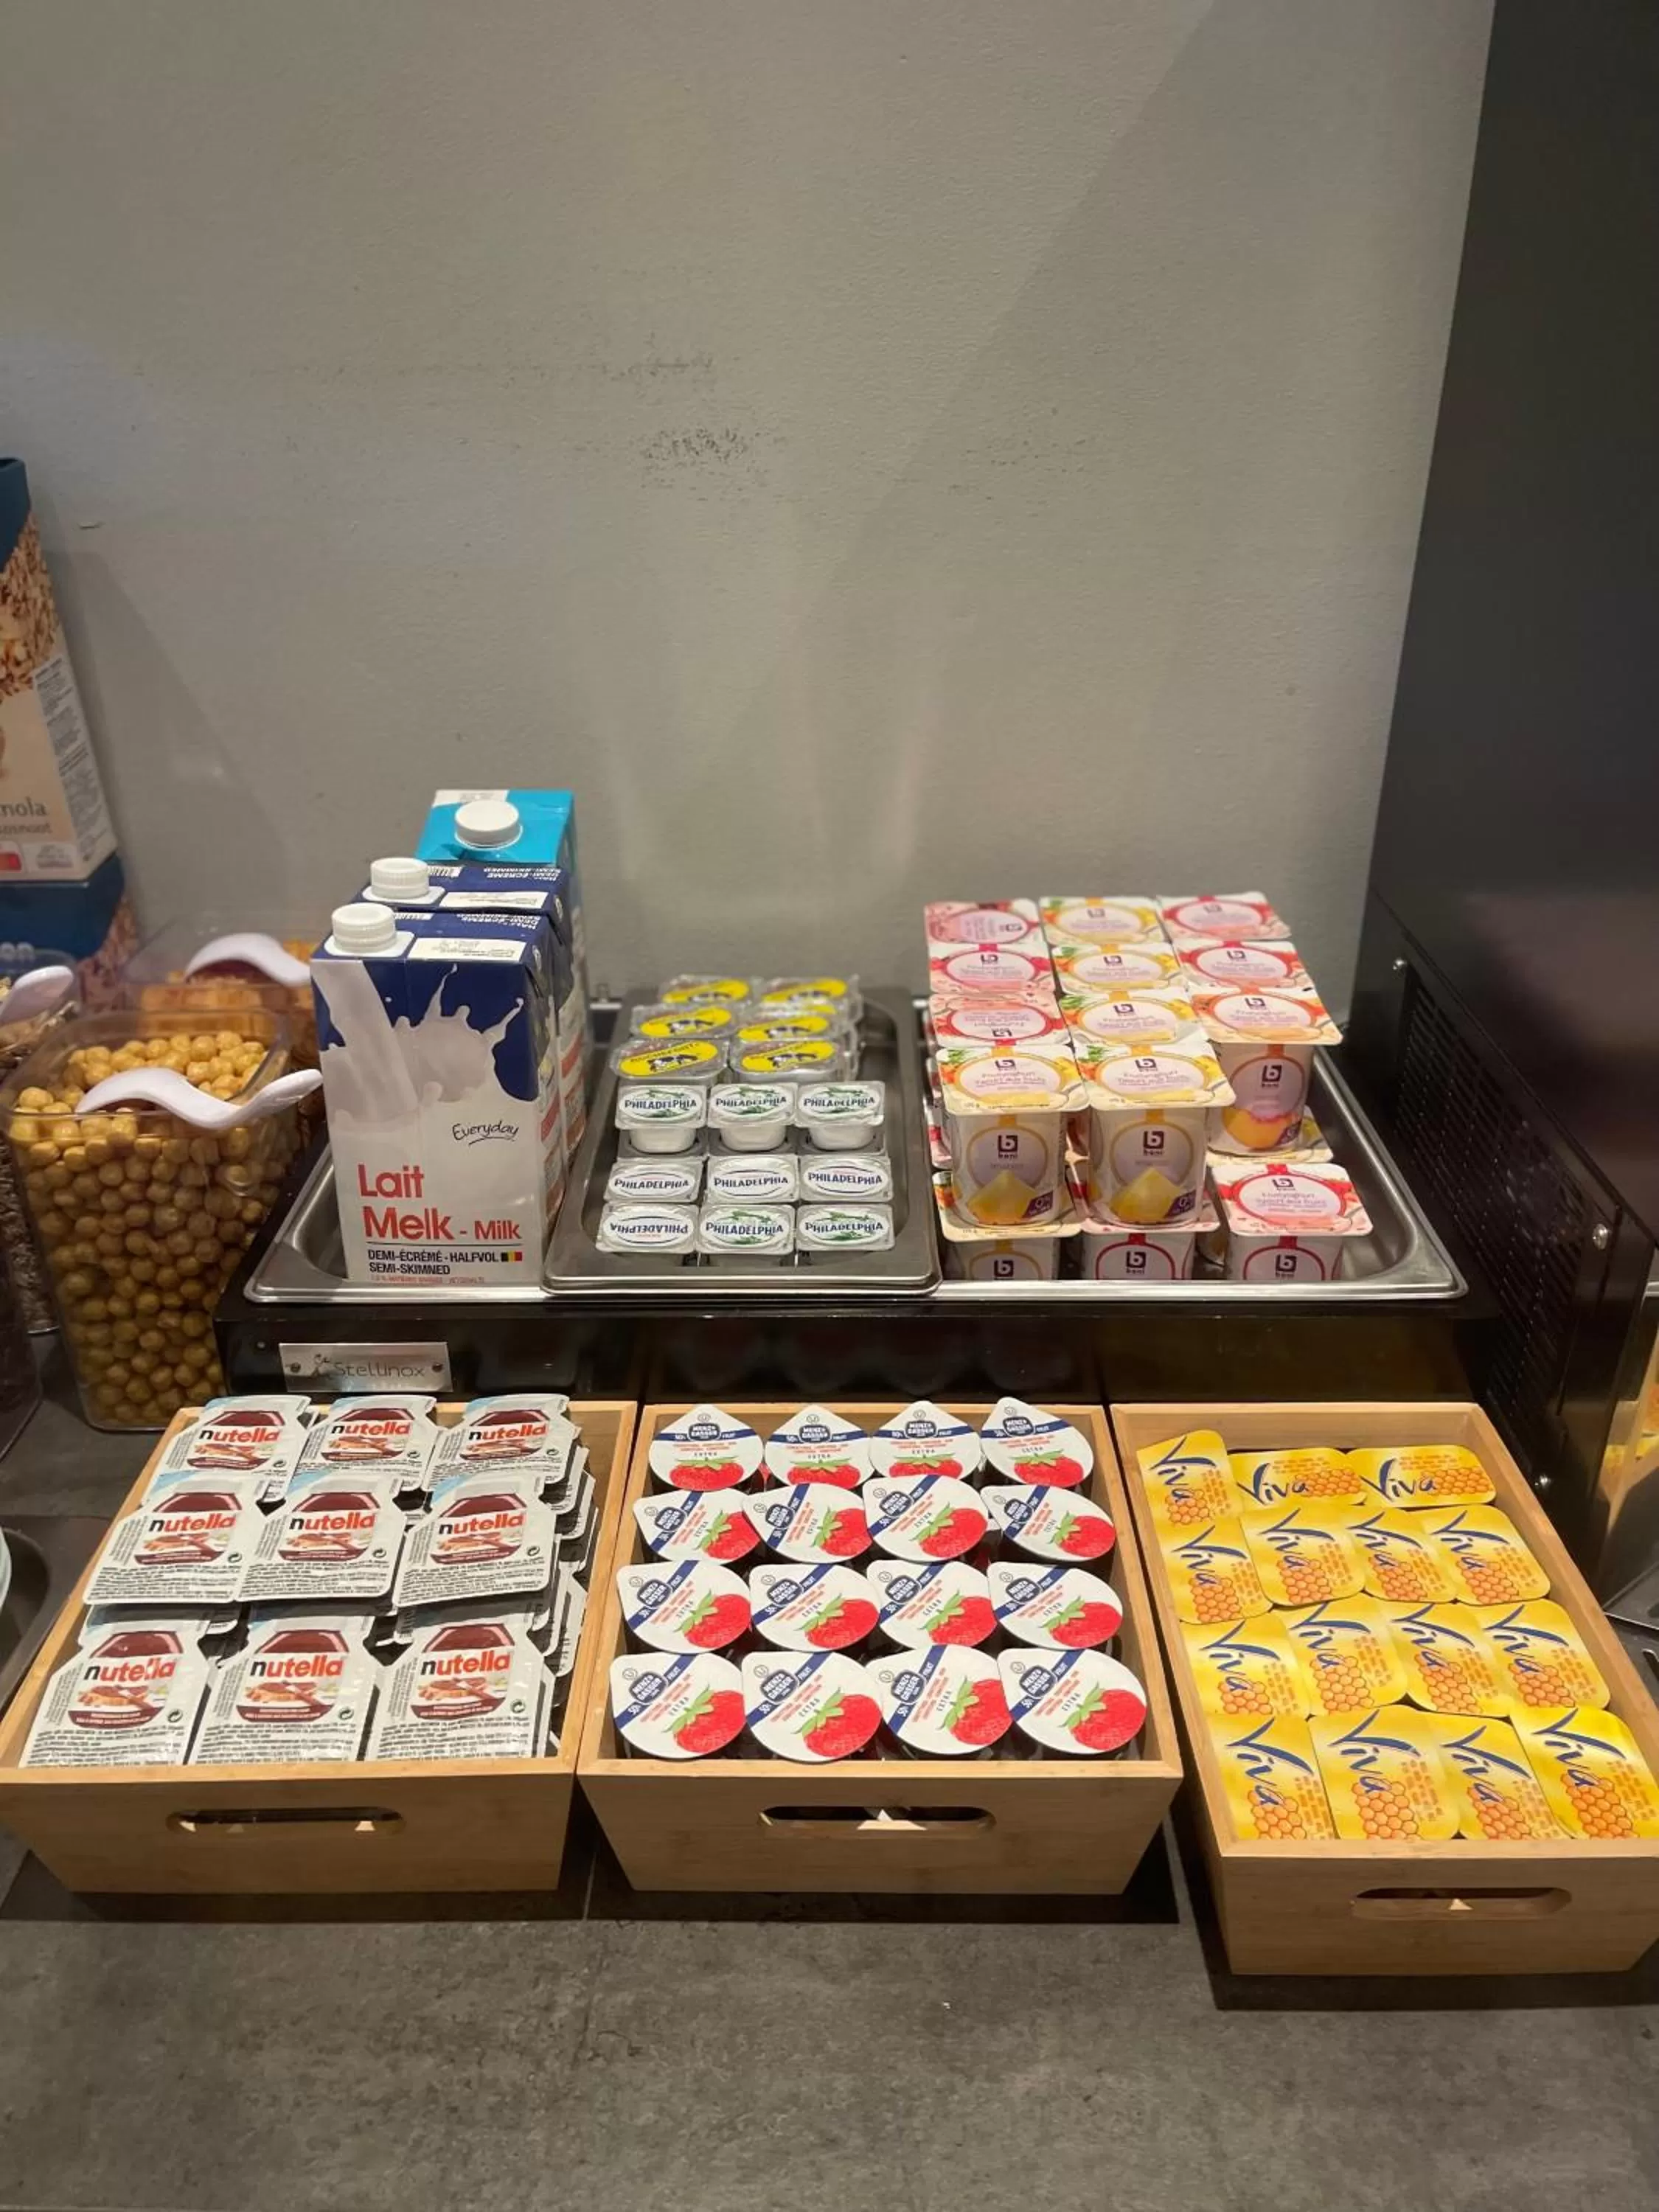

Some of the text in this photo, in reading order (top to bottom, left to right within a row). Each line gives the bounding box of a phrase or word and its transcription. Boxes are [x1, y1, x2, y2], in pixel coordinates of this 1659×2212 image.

[625, 1099, 698, 1110] PHILADELPHIA
[715, 1096, 787, 1107] PHILADELPHIA
[803, 1096, 875, 1107] PHILADELPHIA
[451, 1120, 519, 1141] Everyday
[358, 1164, 424, 1198] Lait
[614, 1179, 689, 1189] PHILADELPHIA
[714, 1176, 789, 1187] PHILADELPHIA
[807, 1172, 883, 1184] PHILADELPHIA
[362, 1206, 454, 1239] Melk
[475, 1220, 522, 1239] Milk
[611, 1222, 689, 1234] PHILADELPHIA
[705, 1221, 785, 1236] PHILADELPHIA
[804, 1221, 884, 1233] PHILADELPHIA
[369, 1249, 442, 1262] DEMI-ÉCRÉMÉ
[450, 1251, 498, 1262] HALFVOL
[369, 1262, 451, 1275] SEMI-SKIMMED
[199, 1427, 282, 1444] nutella
[332, 1422, 411, 1436] nutella
[468, 1423, 548, 1441] nutella
[1149, 1436, 1217, 1503] Viva
[1360, 1458, 1438, 1503] Viva
[1237, 1462, 1310, 1506] Viva
[149, 1513, 236, 1532] nutella
[289, 1512, 375, 1531] nutella
[439, 1513, 524, 1535] nutella
[1258, 1508, 1335, 1568] Viva
[1346, 1512, 1423, 1568] Viva
[1430, 1510, 1510, 1570] Viva
[1171, 1525, 1248, 1585] Viva
[1290, 1602, 1371, 1669] Viva
[1391, 1603, 1475, 1668] Viva
[1484, 1604, 1569, 1674] Viva
[251, 1656, 344, 1677] nutella
[420, 1650, 511, 1676] nutella
[1199, 1620, 1281, 1691] Viva
[84, 1658, 177, 1682] nutella
[1329, 1709, 1422, 1794] Viva
[1531, 1707, 1627, 1787] Viva
[1225, 1717, 1314, 1806] Viva
[1440, 1725, 1533, 1802] Viva
